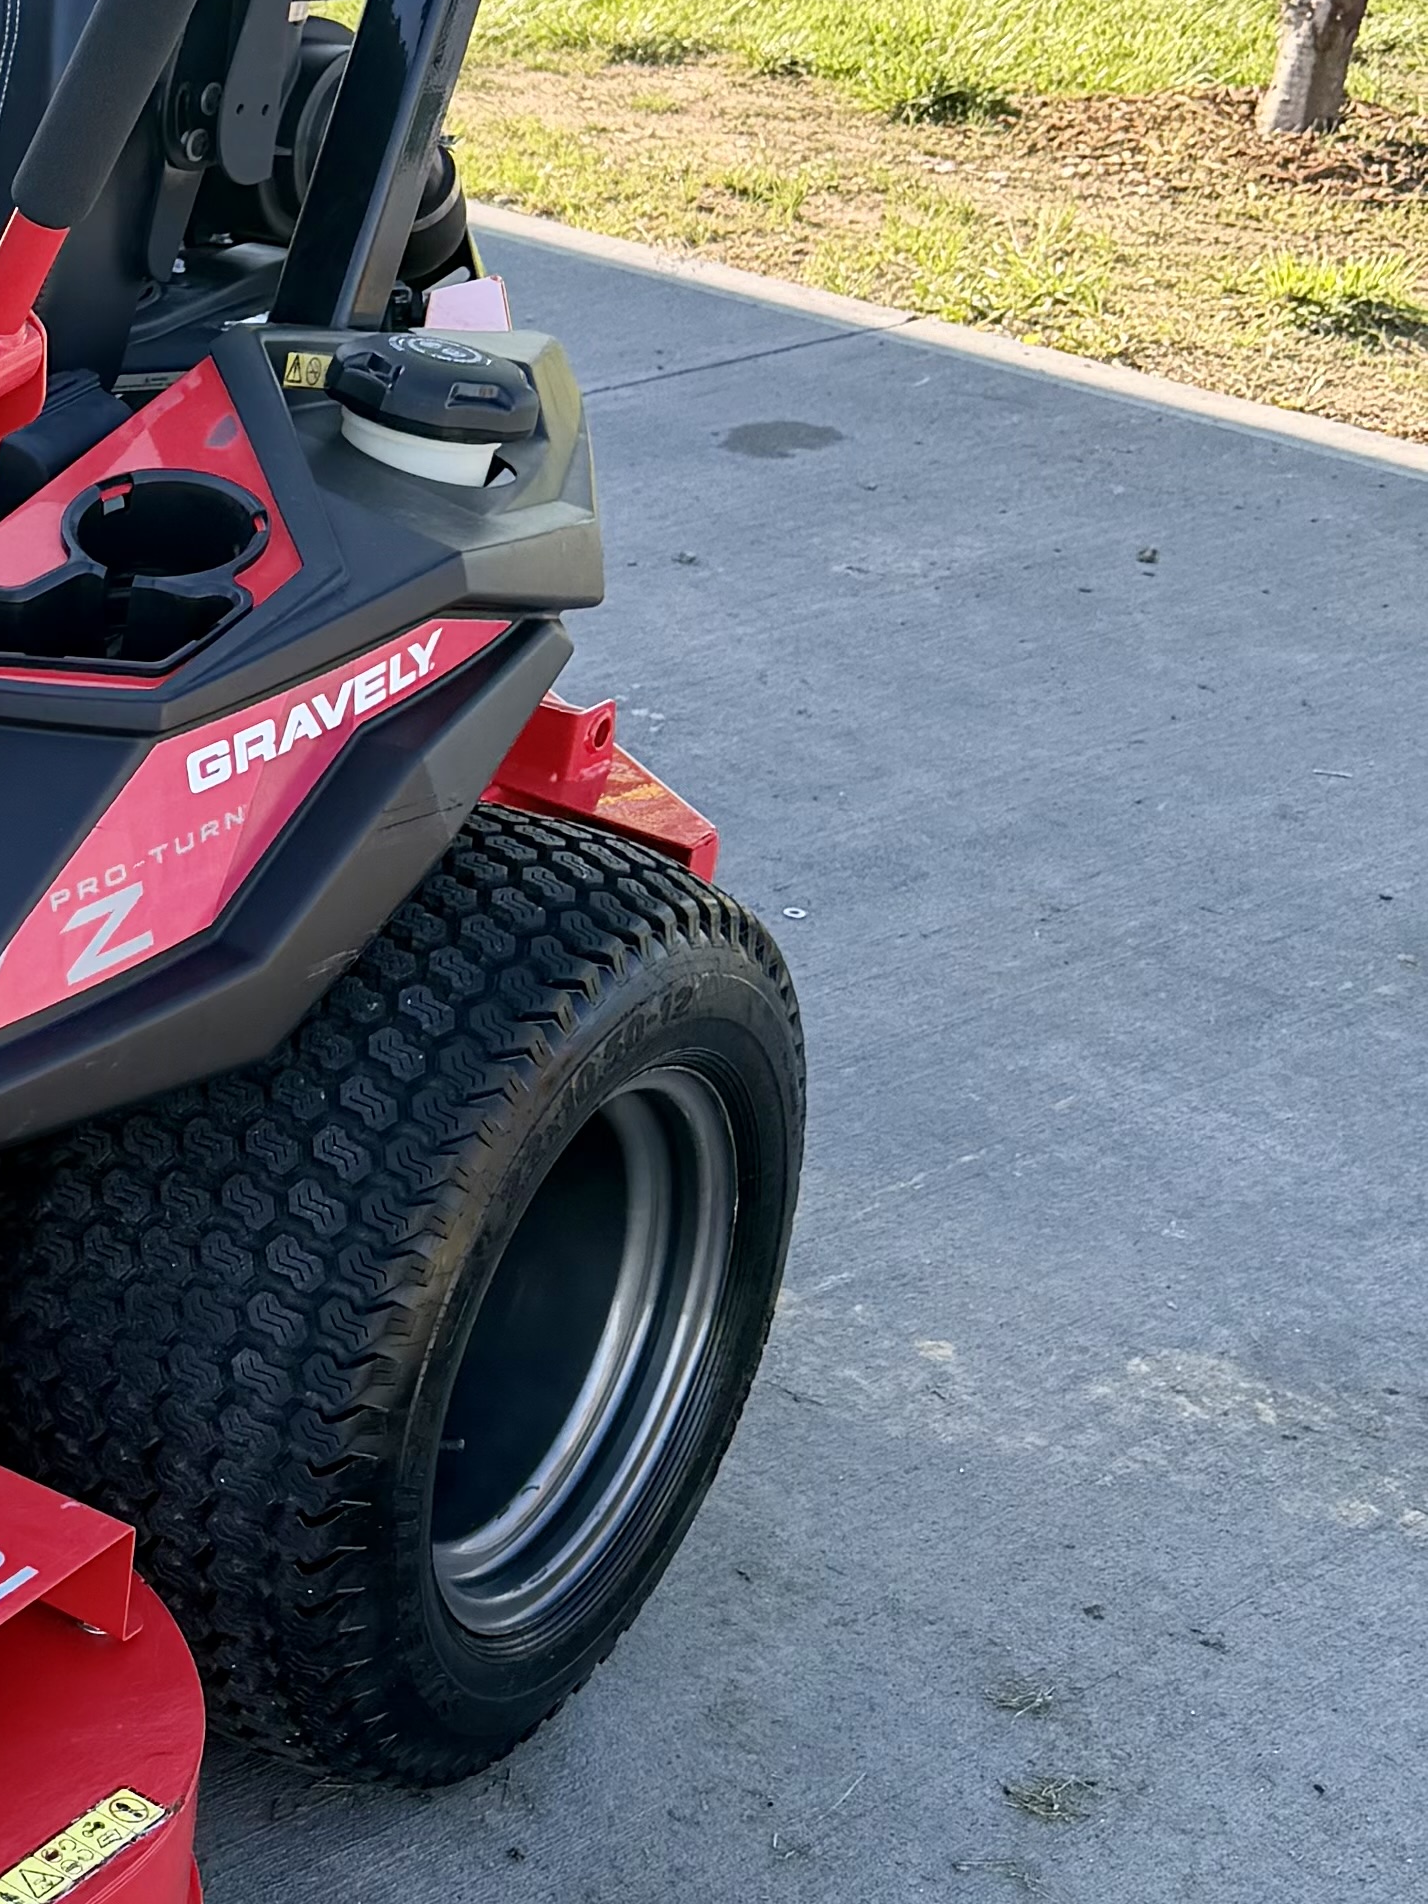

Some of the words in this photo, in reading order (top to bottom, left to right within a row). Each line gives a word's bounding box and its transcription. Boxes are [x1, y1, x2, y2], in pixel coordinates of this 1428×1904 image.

[185, 627, 443, 794] GRAVELY
[49, 805, 247, 912] PRO-TURN
[59, 881, 154, 986] Z
